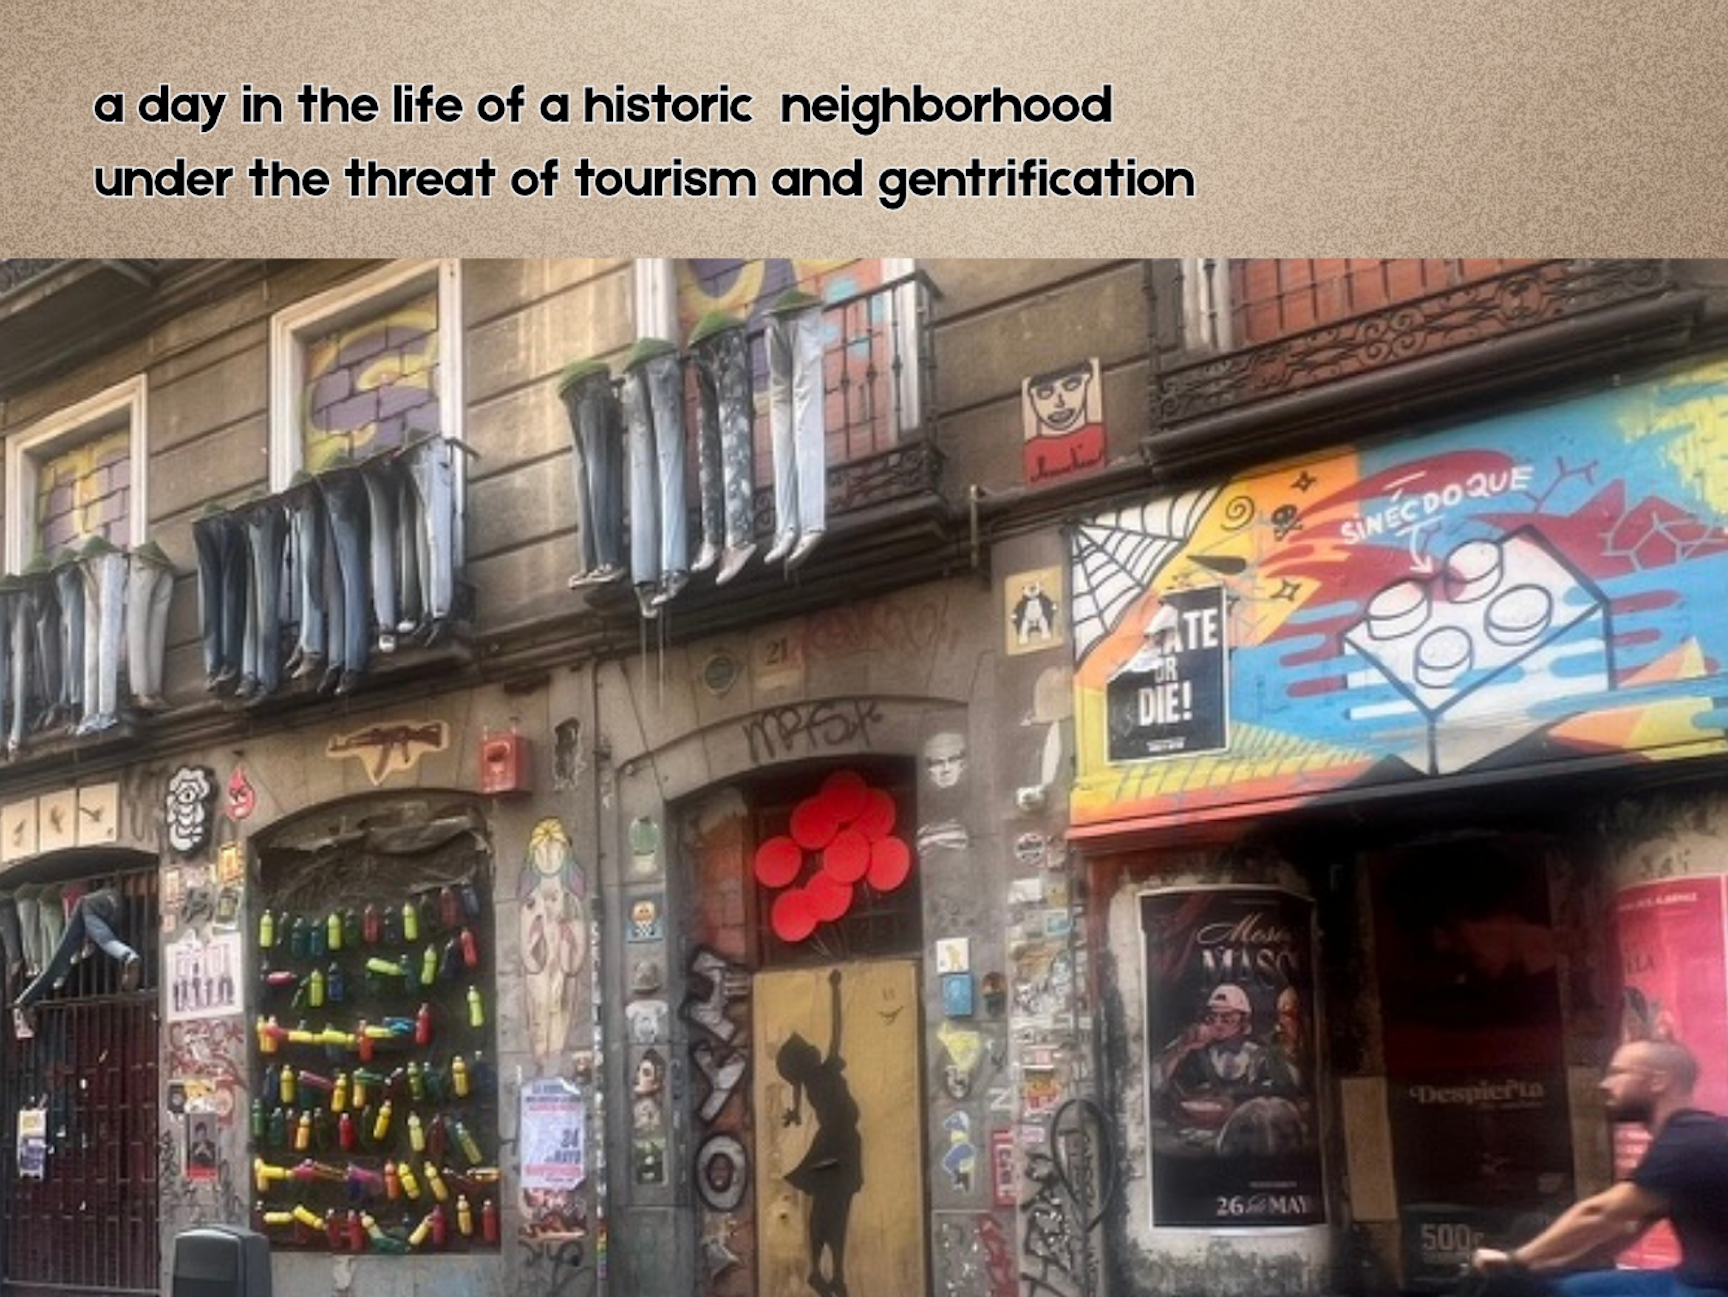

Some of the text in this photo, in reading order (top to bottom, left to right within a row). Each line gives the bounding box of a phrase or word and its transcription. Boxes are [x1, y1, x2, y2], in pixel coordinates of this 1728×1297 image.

[765, 637, 789, 667] 21
[1137, 680, 1194, 727] DIE!
[1216, 1194, 1244, 1217] 26
